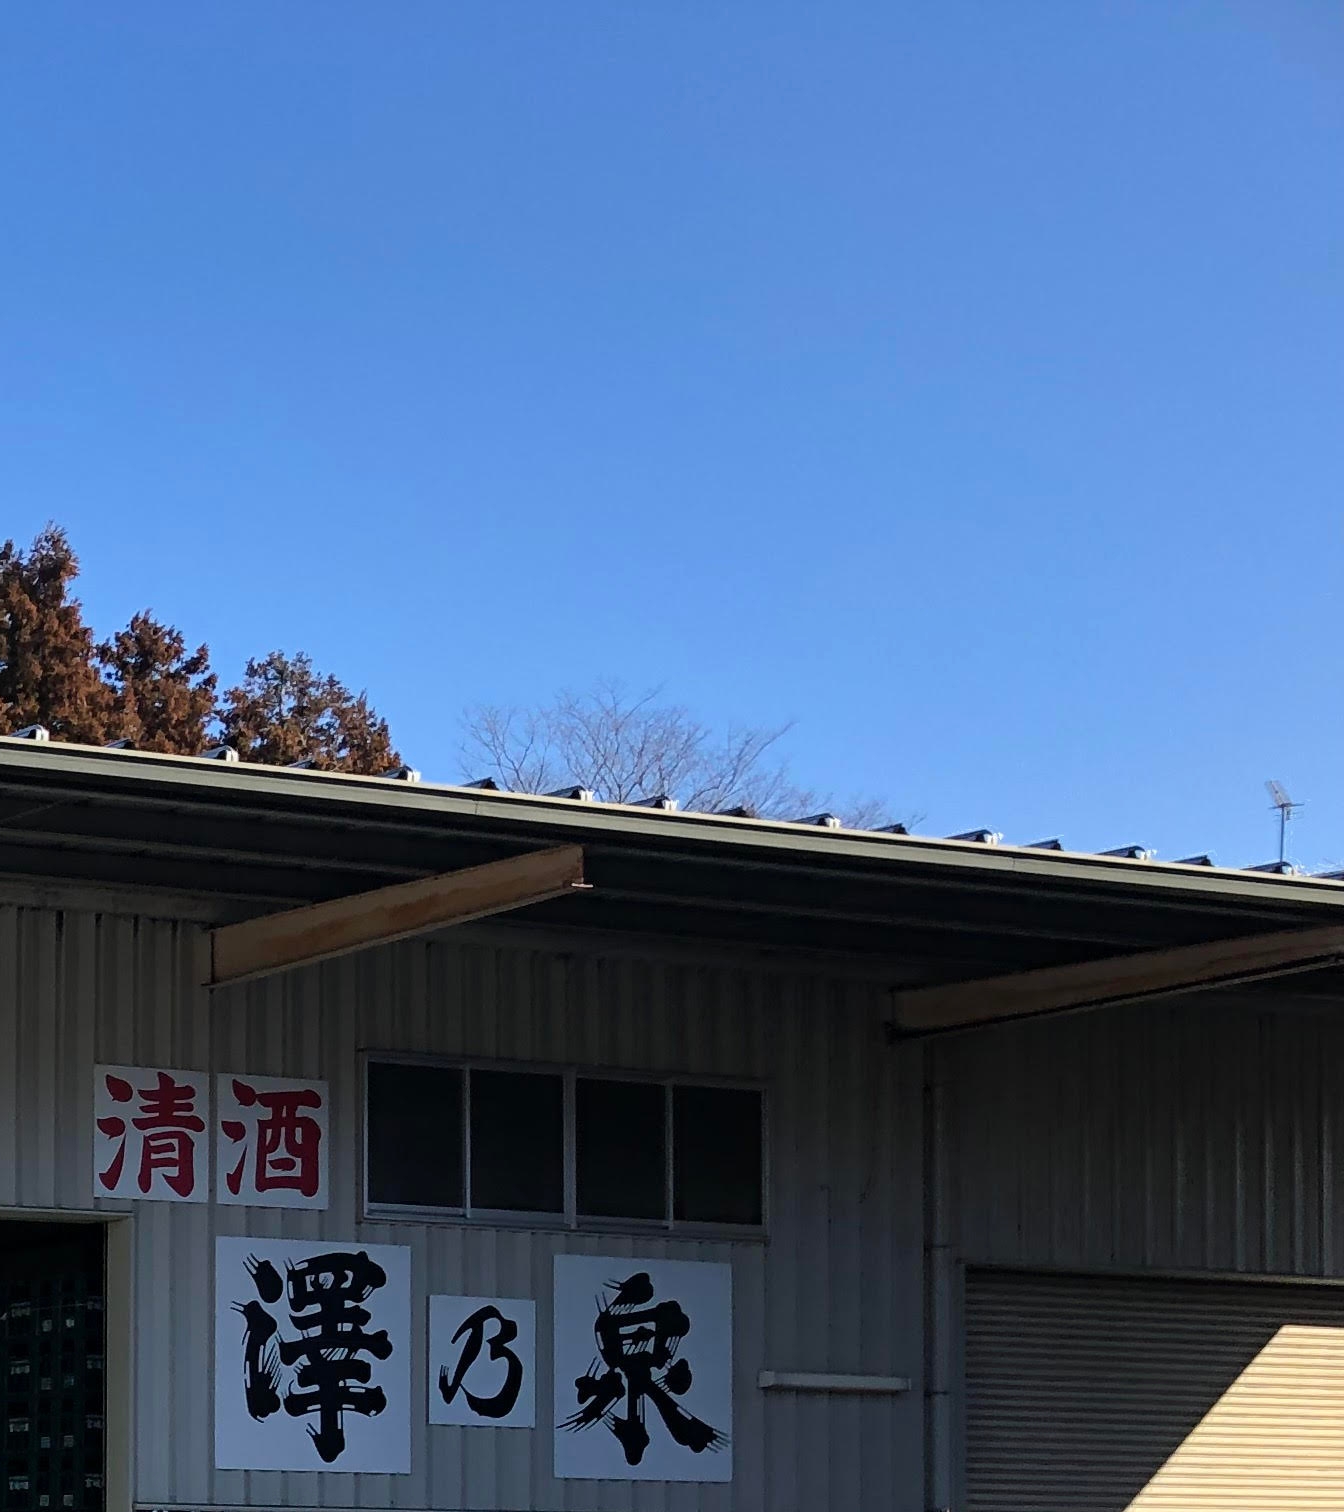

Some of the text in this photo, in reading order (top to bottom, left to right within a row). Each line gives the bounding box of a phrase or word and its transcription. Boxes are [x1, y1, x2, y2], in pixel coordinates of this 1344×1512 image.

[96, 1071, 323, 1198] 清酒
[231, 1251, 729, 1465] 澤乃泉
